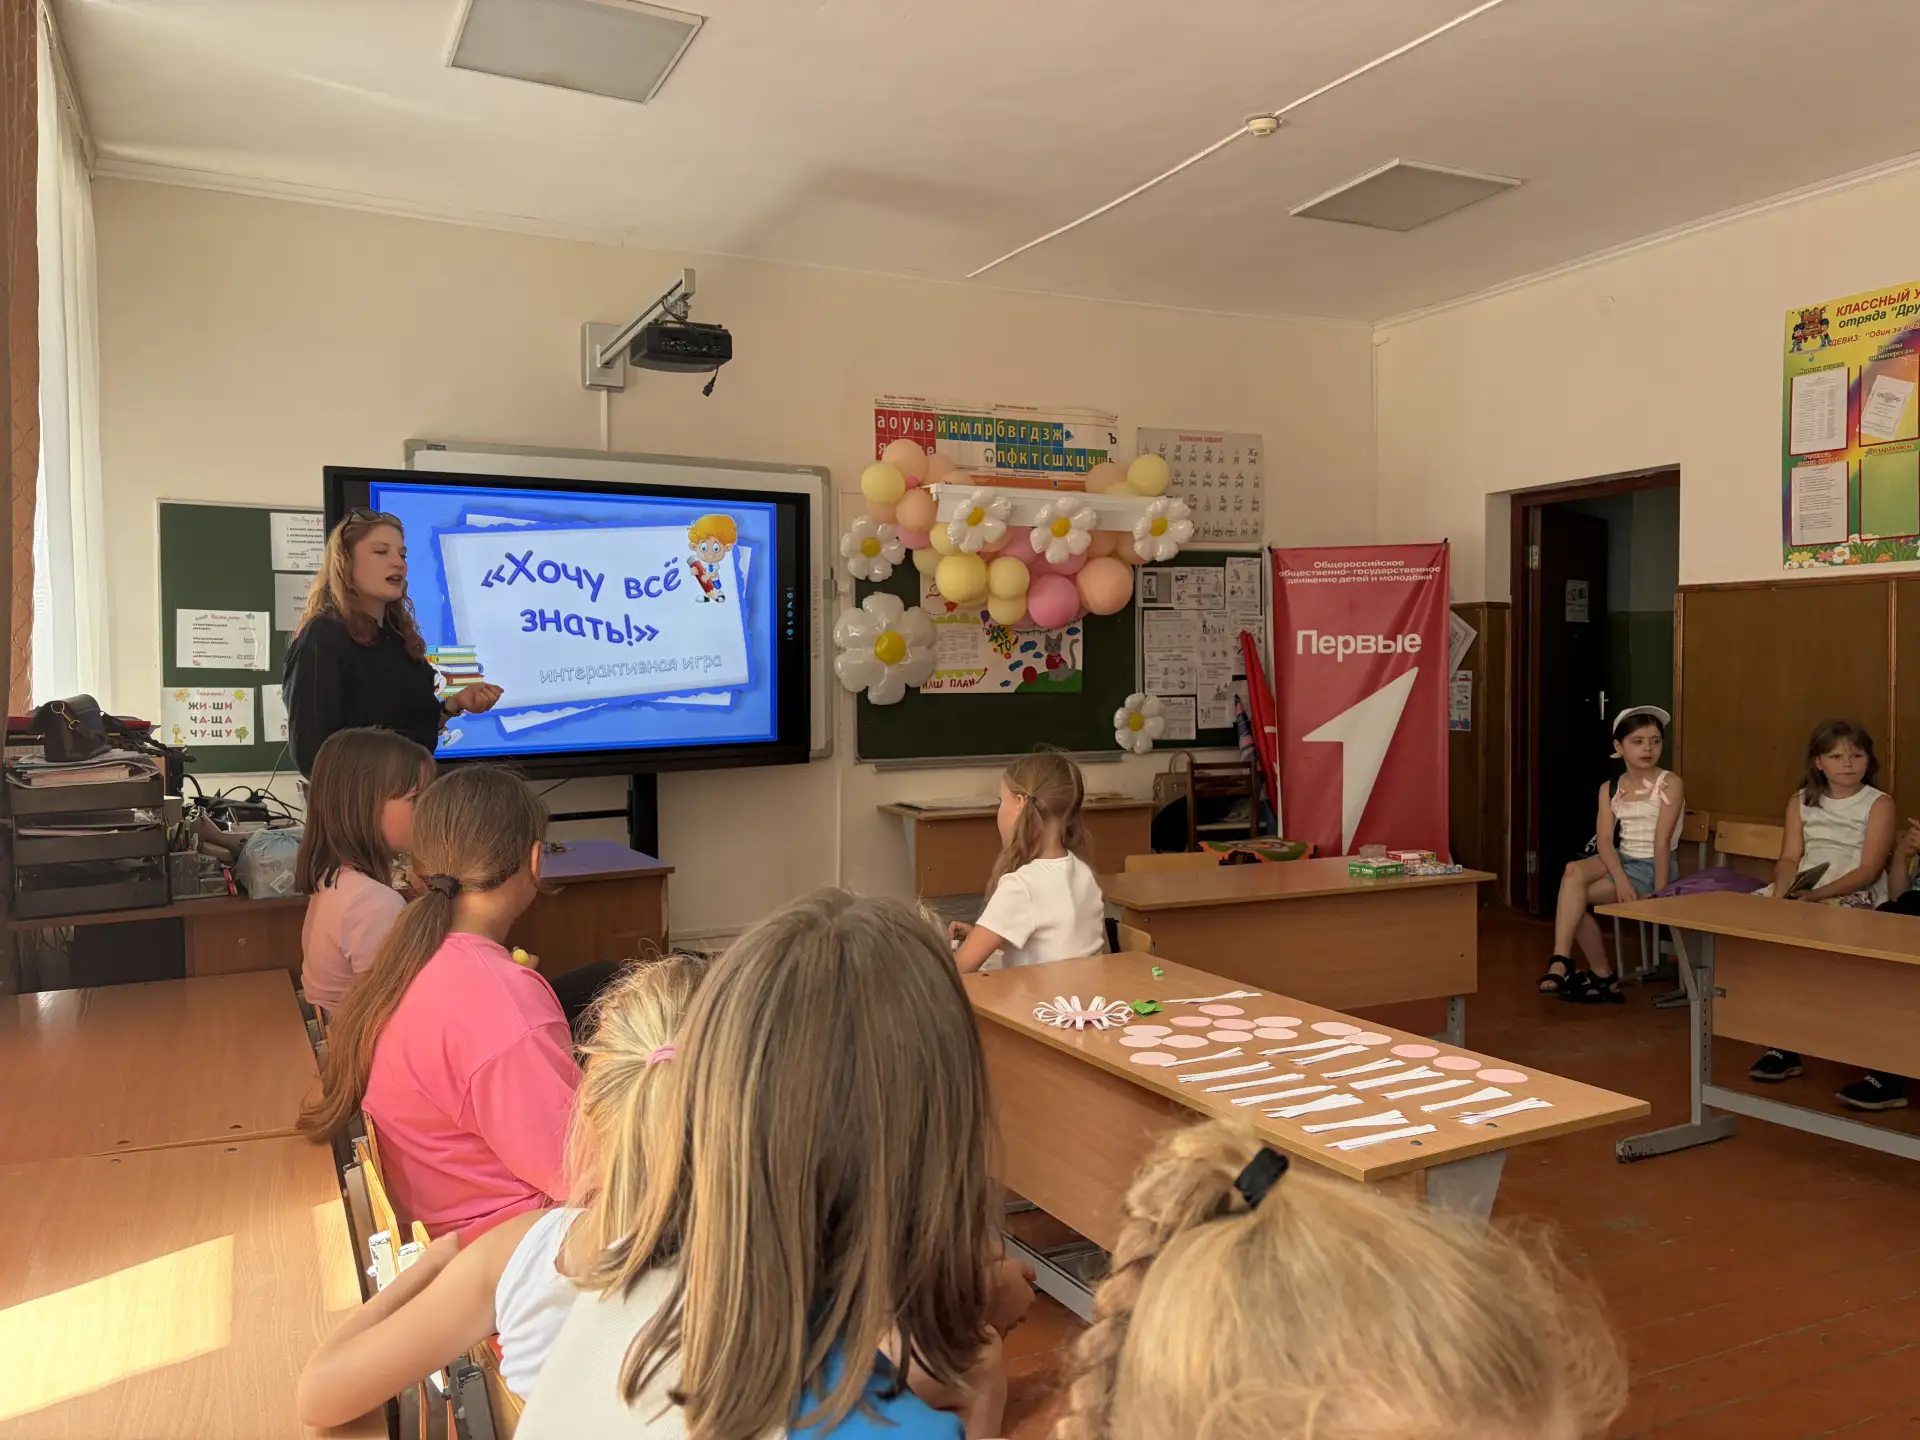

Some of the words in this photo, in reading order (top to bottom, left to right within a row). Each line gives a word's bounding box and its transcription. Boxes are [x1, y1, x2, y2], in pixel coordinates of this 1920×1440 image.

[1836, 288, 1911, 317] КЛАССНЫЙ
[1839, 311, 1887, 328] отряда
[1829, 335, 1861, 348] ДЕВИЗ:
[1314, 559, 1404, 568] Общероссийское
[481, 550, 605, 602] «Хочу
[624, 557, 682, 599] всё
[1353, 566, 1441, 575] государственное
[1287, 576, 1337, 585] движение
[1339, 575, 1369, 583] детей
[1379, 574, 1433, 582] молодёжи
[519, 608, 659, 646] знать!»
[1296, 630, 1422, 662] Первые
[539, 656, 678, 685] интерактивная
[681, 653, 723, 675] игра
[188, 702, 232, 710] ЖИ-ШИ
[190, 716, 232, 724] ЧА-ЩА
[190, 730, 232, 738] ЧУ-ЩУ
